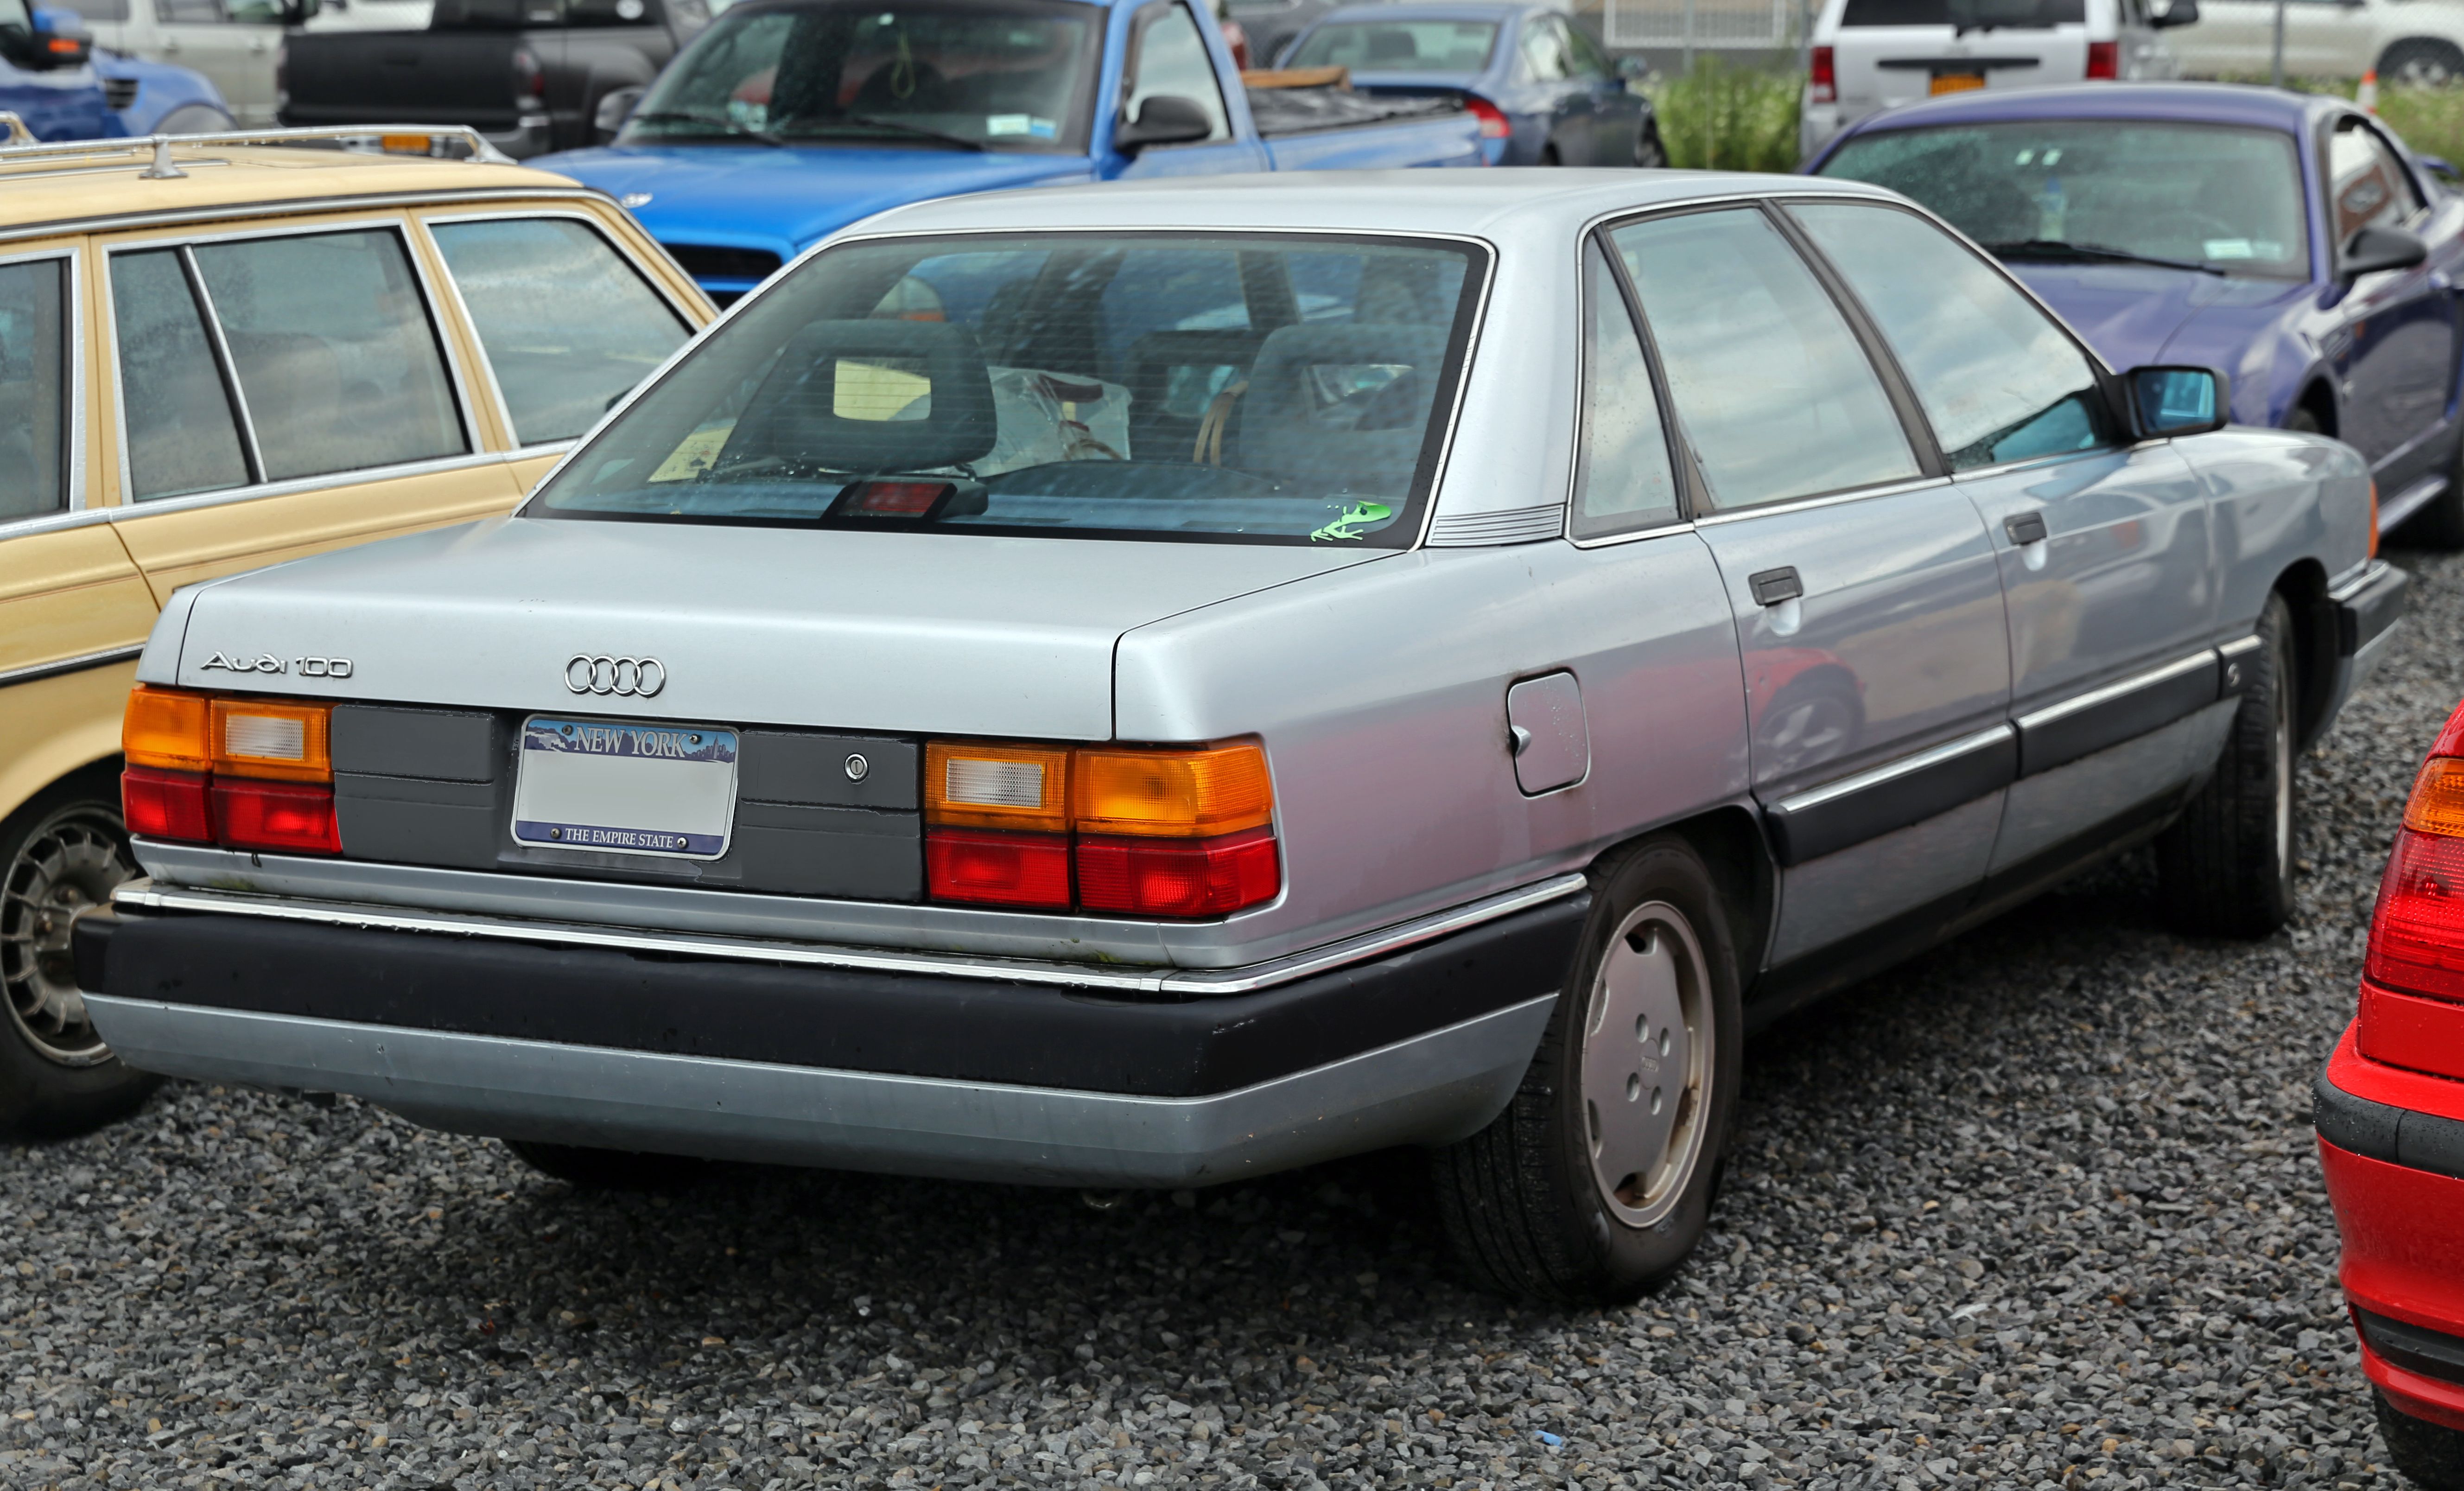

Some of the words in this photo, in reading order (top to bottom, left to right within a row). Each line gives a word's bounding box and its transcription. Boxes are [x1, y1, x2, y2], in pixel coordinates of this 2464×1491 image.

[200, 651, 287, 674] Audi
[296, 656, 353, 678] 100
[574, 727, 625, 753] NEW
[631, 730, 688, 758] YORK
[565, 828, 590, 842] THE
[592, 830, 636, 845] EMPIRE
[638, 834, 673, 848] STATE
